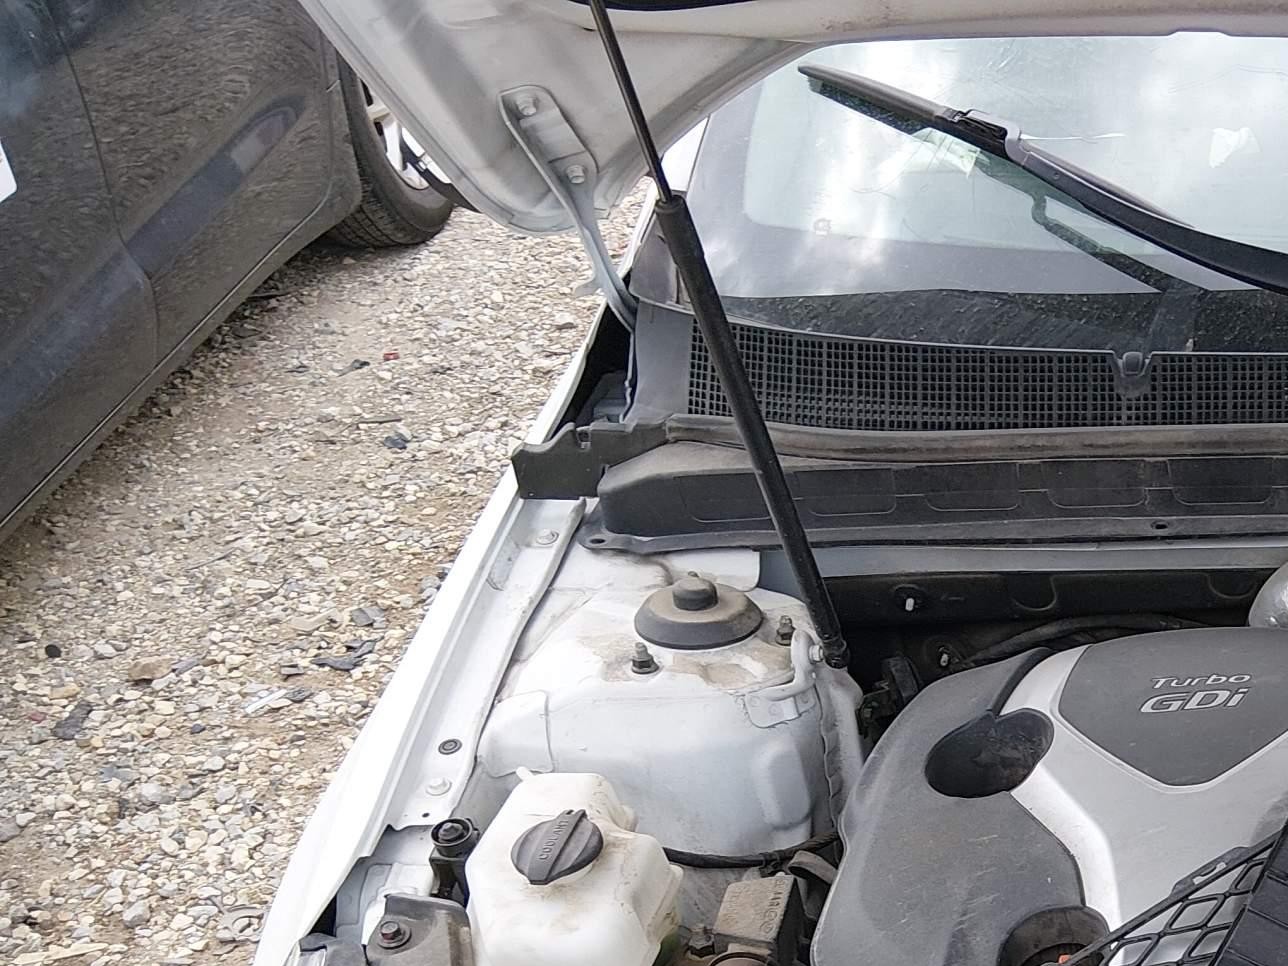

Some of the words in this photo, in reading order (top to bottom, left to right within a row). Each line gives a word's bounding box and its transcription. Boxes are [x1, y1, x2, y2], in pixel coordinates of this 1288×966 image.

[1151, 674, 1251, 689] Turbo
[1140, 688, 1250, 713] GDi
[538, 820, 569, 861] COOLANT
